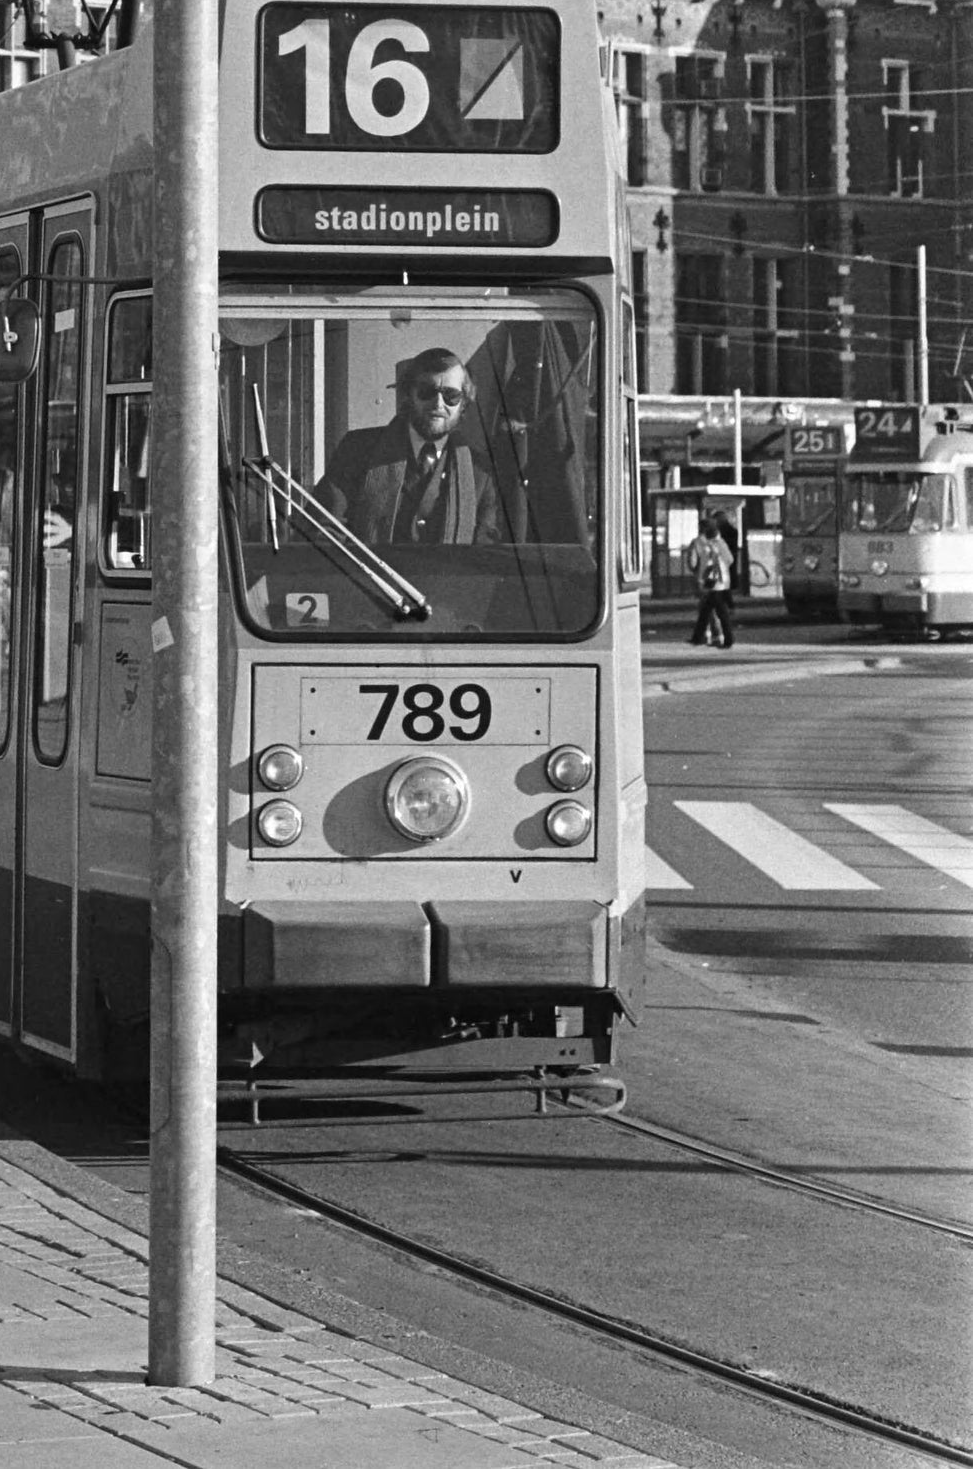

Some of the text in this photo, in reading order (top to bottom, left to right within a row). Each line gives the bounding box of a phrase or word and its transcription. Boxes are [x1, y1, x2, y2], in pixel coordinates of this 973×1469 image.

[278, 18, 431, 137] 16
[314, 203, 500, 237] stadionplein
[859, 411, 899, 438] 24
[794, 431, 825, 453] 25
[297, 595, 318, 624] 2
[359, 683, 492, 742] 789
